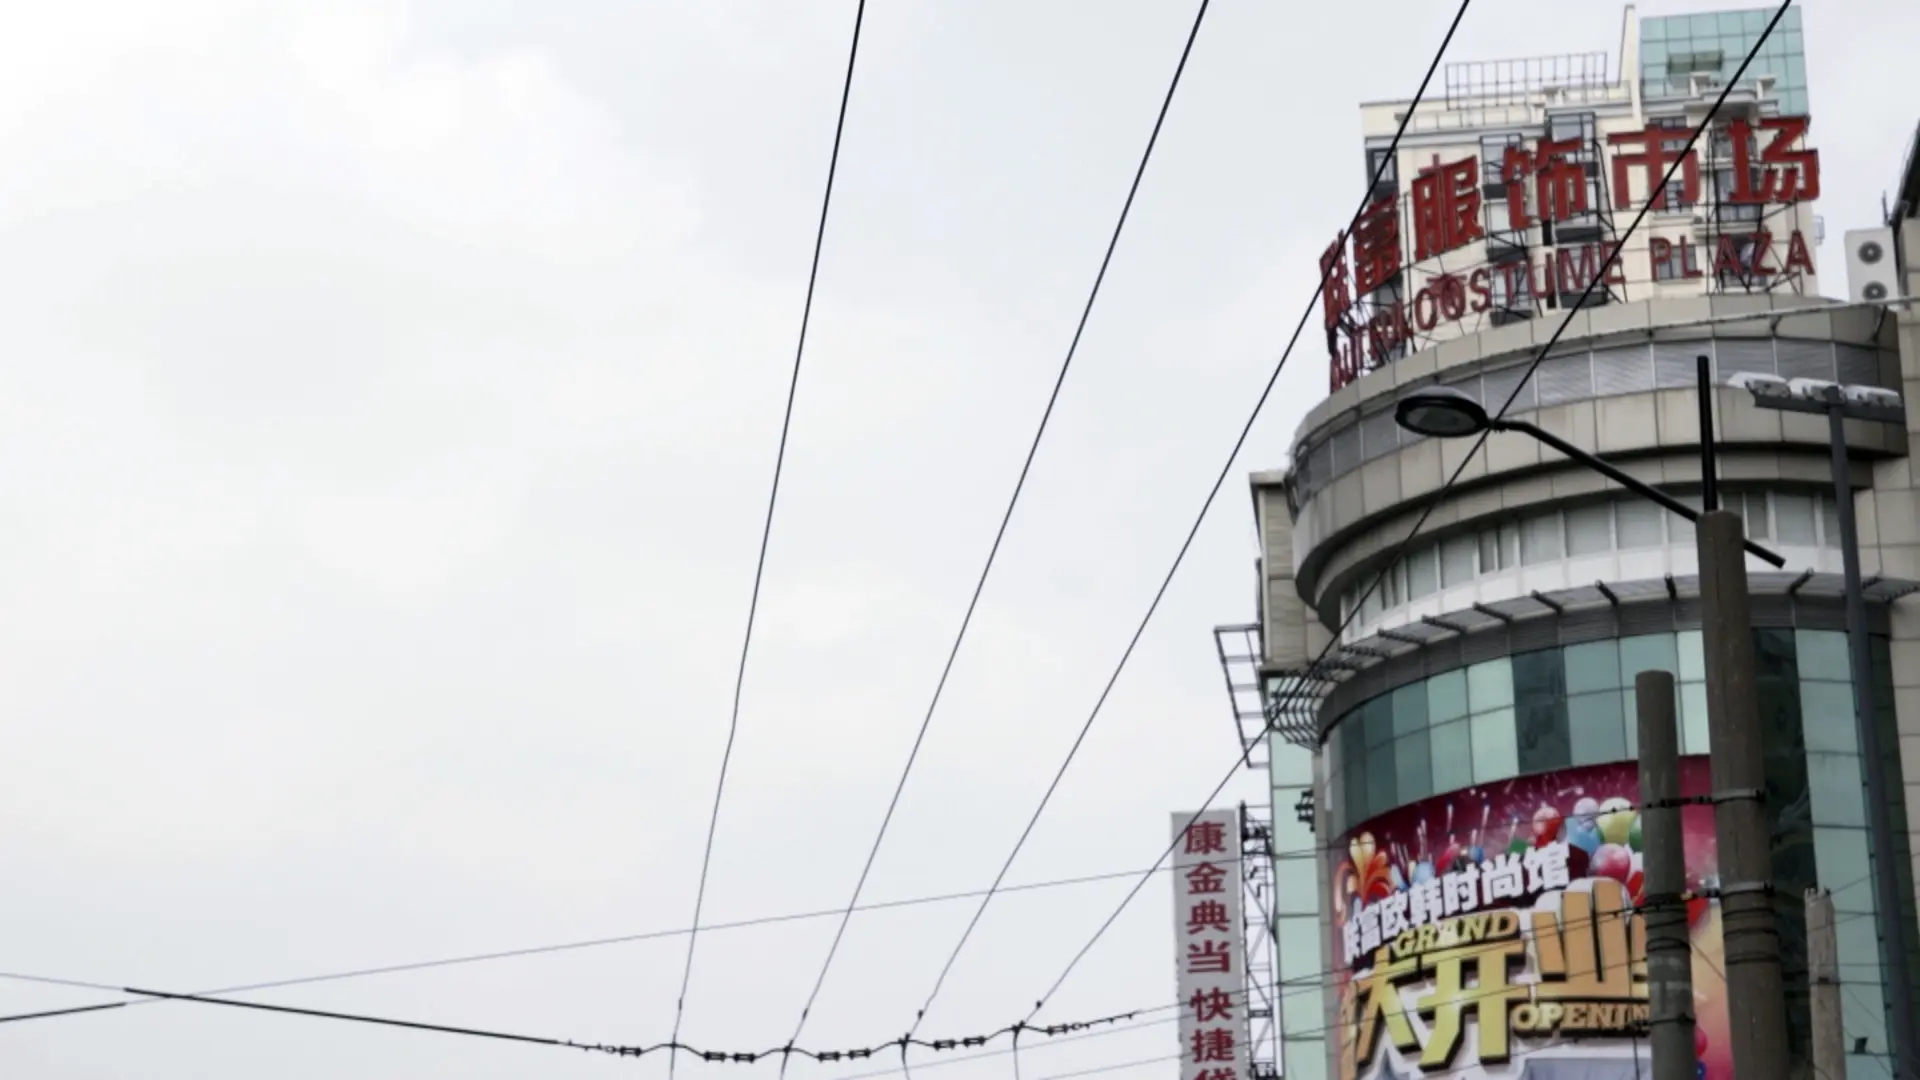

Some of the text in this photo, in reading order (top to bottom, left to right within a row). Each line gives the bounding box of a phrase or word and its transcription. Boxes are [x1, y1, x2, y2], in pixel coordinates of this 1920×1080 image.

[1649, 228, 1815, 282] PLAZA
[1184, 821, 1231, 974] 康金典当
[1393, 910, 1520, 957] GRAND
[1340, 880, 1648, 1080] 大开业
[1512, 1001, 1649, 1032] OPENIN
